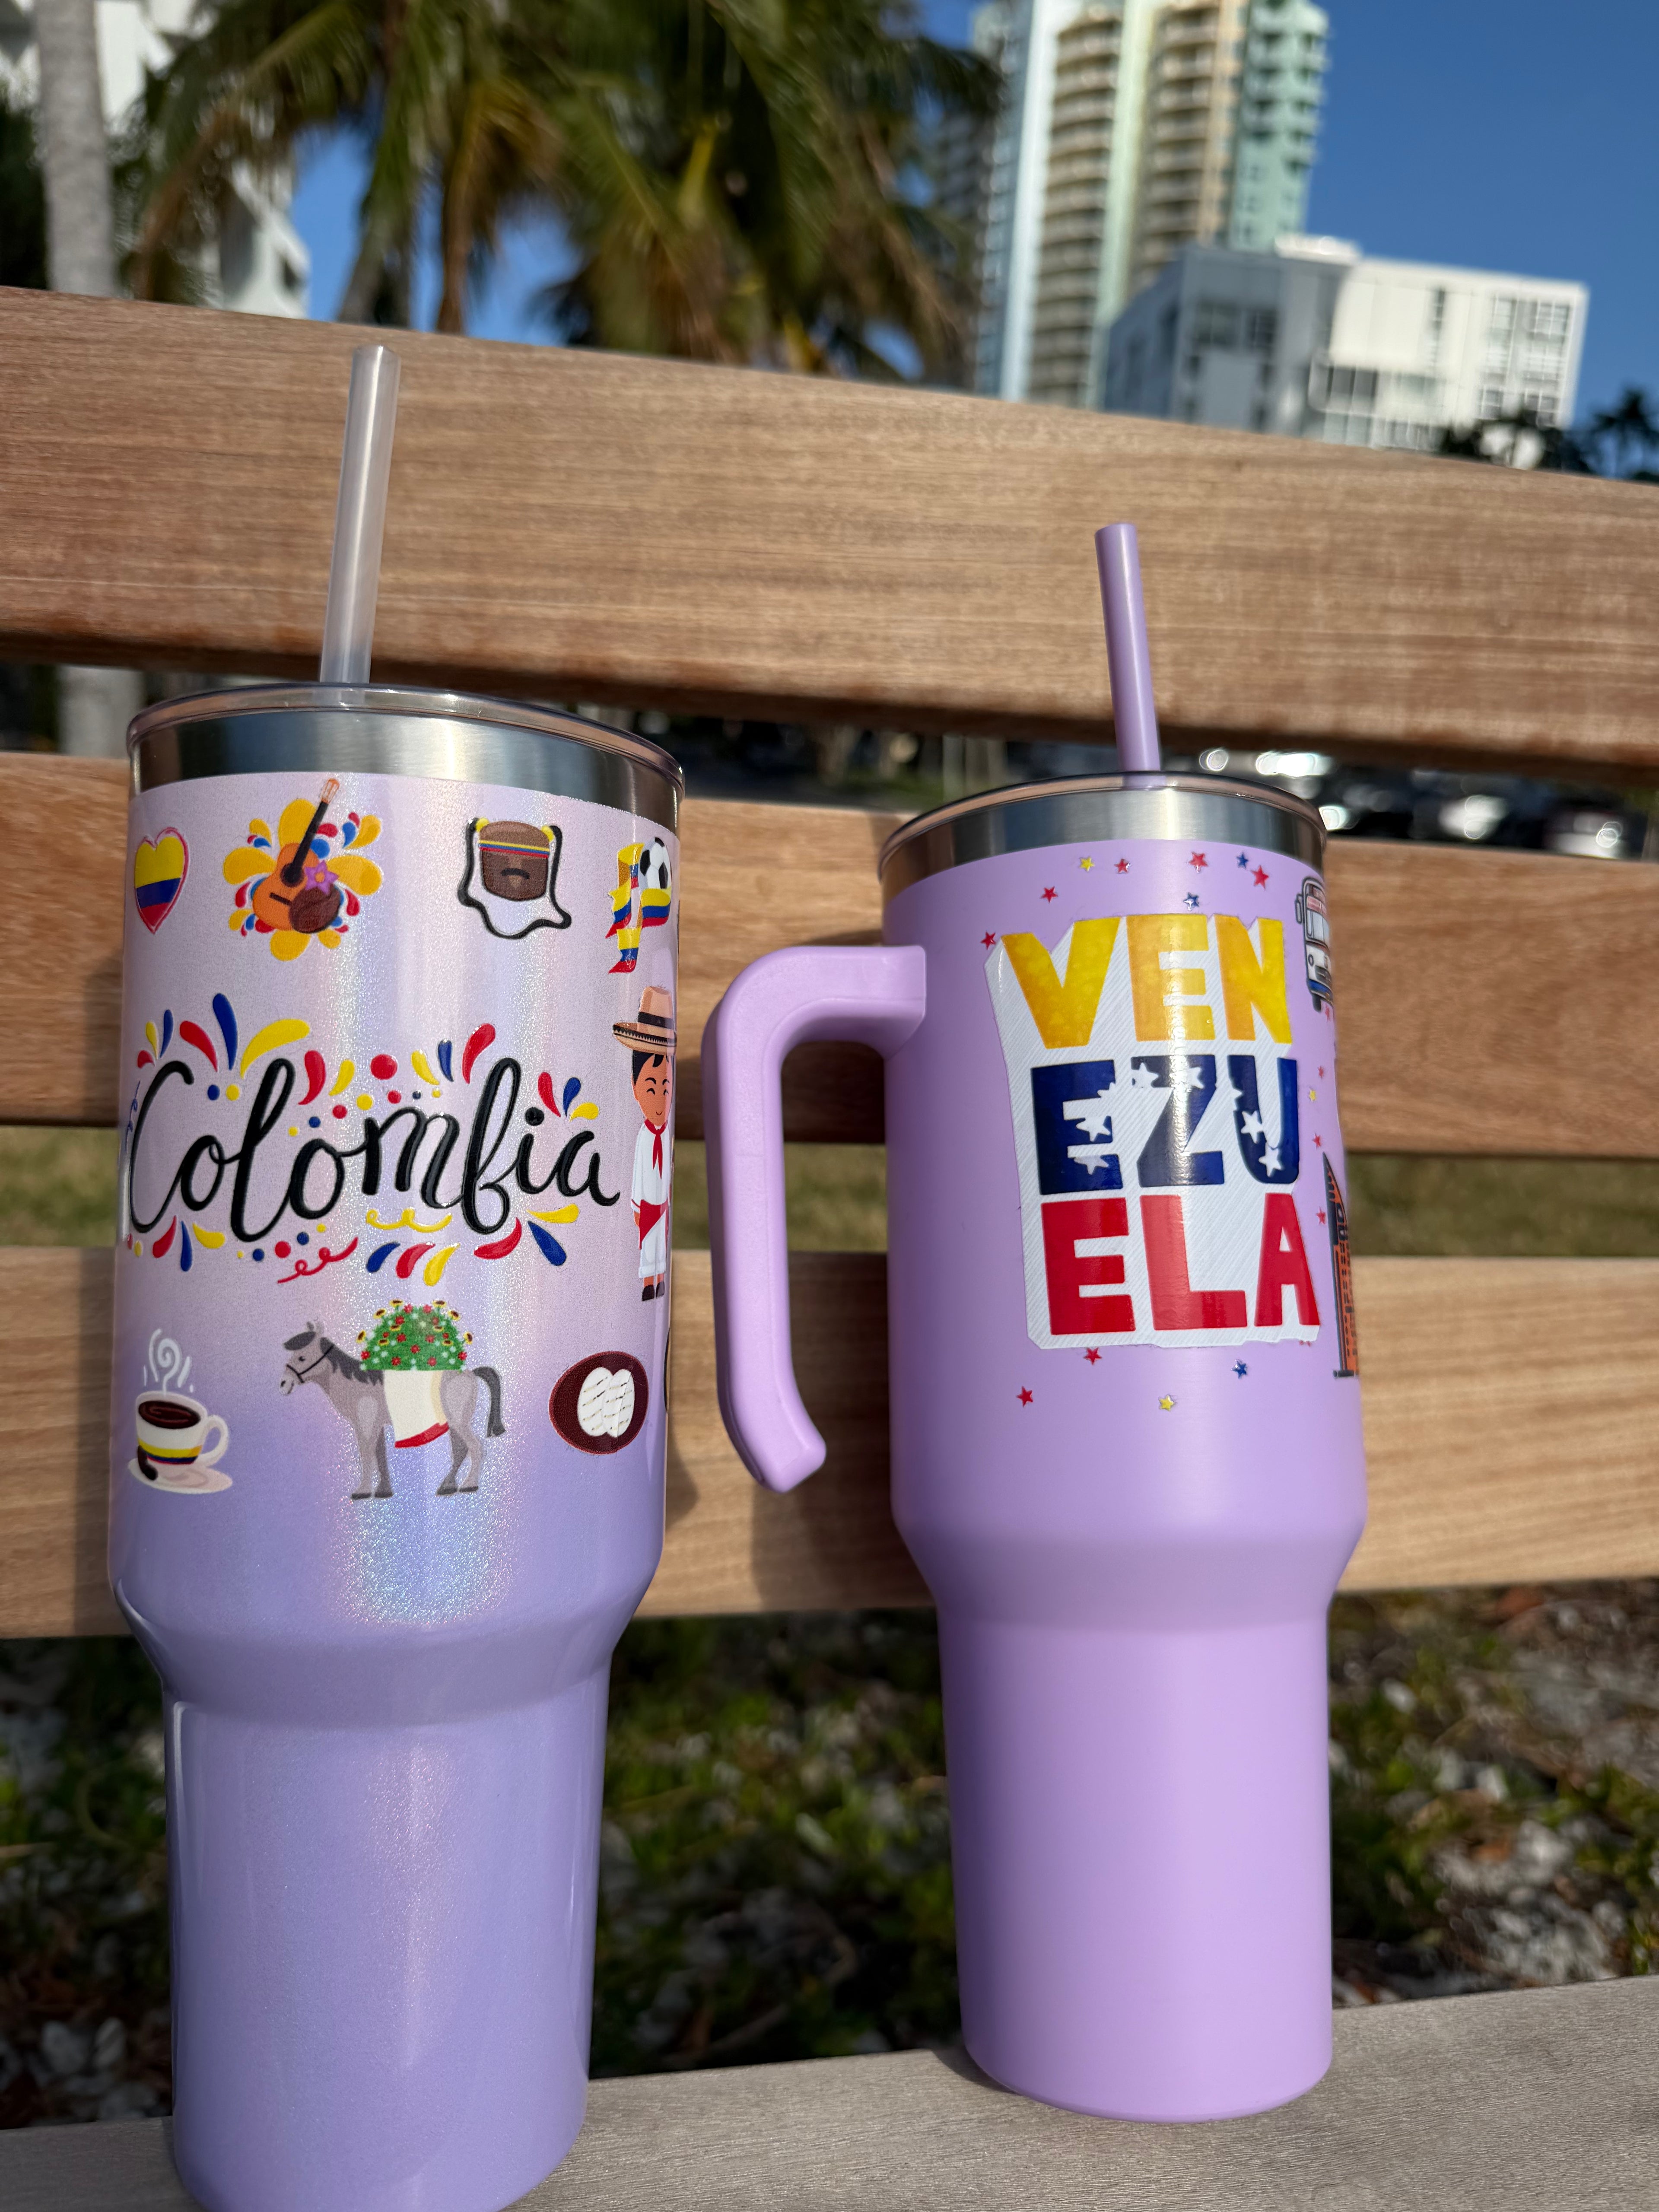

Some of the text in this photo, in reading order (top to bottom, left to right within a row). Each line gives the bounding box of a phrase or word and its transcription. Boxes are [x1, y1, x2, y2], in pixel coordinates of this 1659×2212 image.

[1001, 914, 1292, 1050] VEN
[129, 1058, 620, 1243] Colombia
[1030, 1055, 1299, 1195] EZU
[1040, 1192, 1320, 1335] ELA
